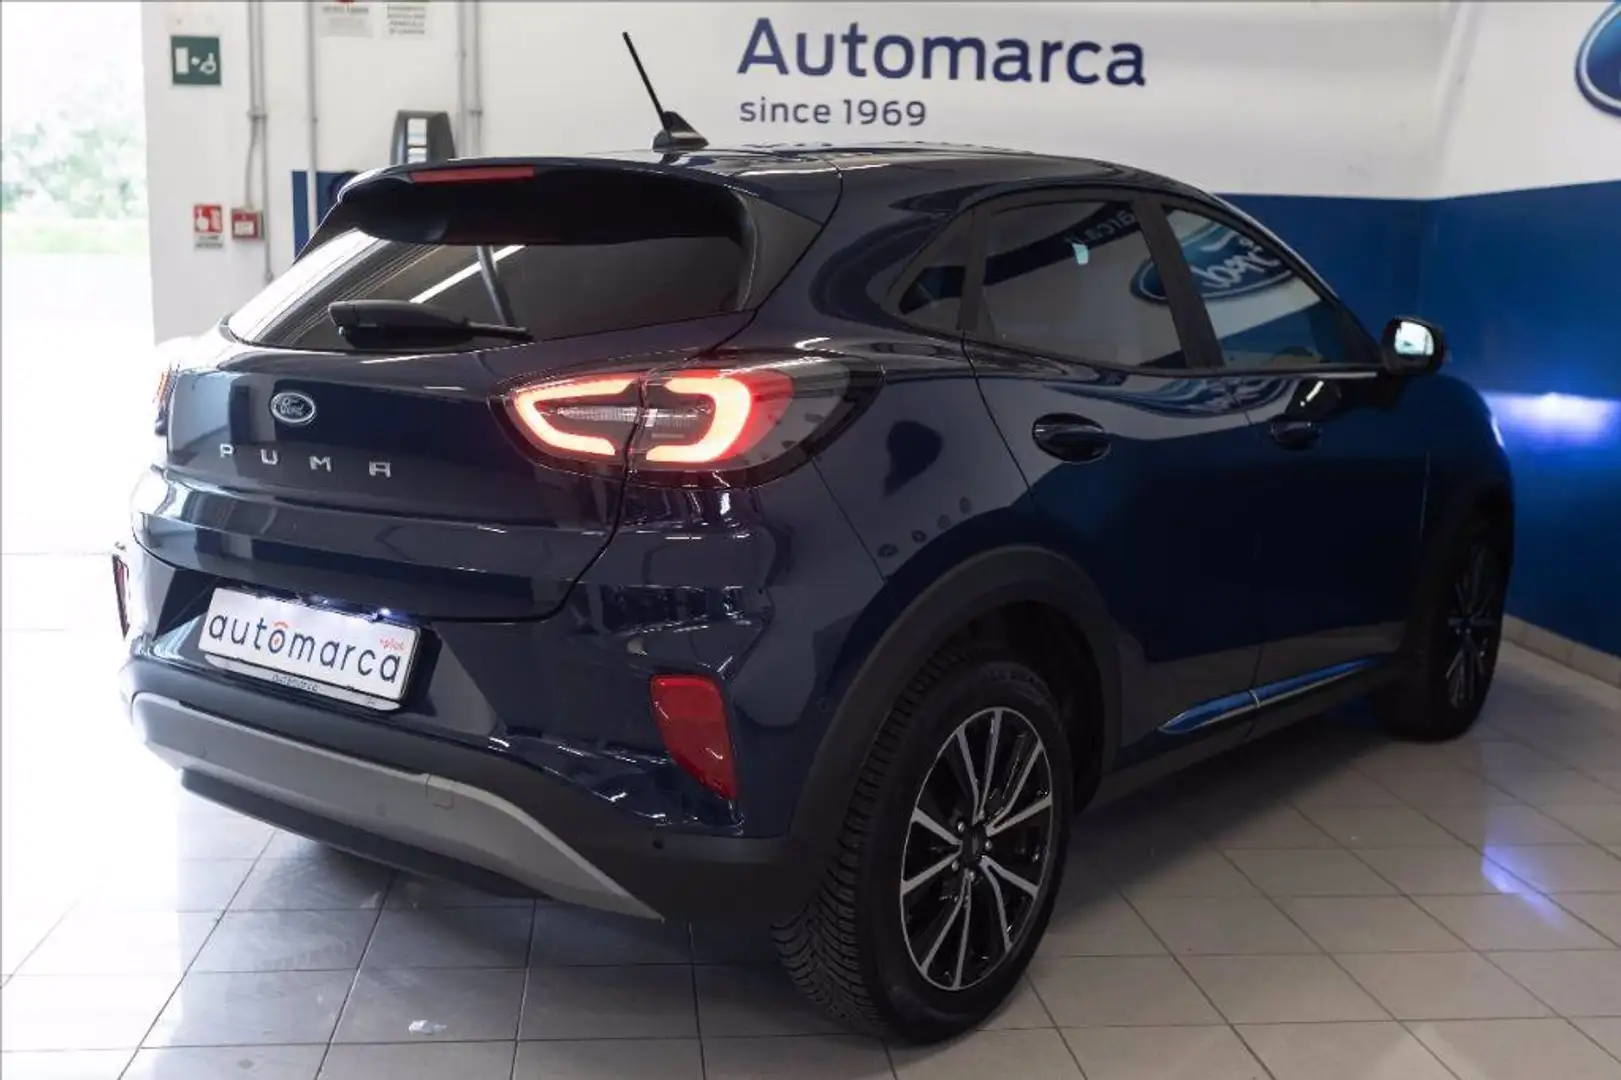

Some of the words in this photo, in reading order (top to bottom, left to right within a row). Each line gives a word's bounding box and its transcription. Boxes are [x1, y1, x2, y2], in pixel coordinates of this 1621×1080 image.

[737, 17, 1146, 87] Automarca
[739, 95, 832, 125] since
[843, 98, 928, 127] 1969
[219, 443, 392, 478] PUMA
[208, 614, 402, 683] automarca
